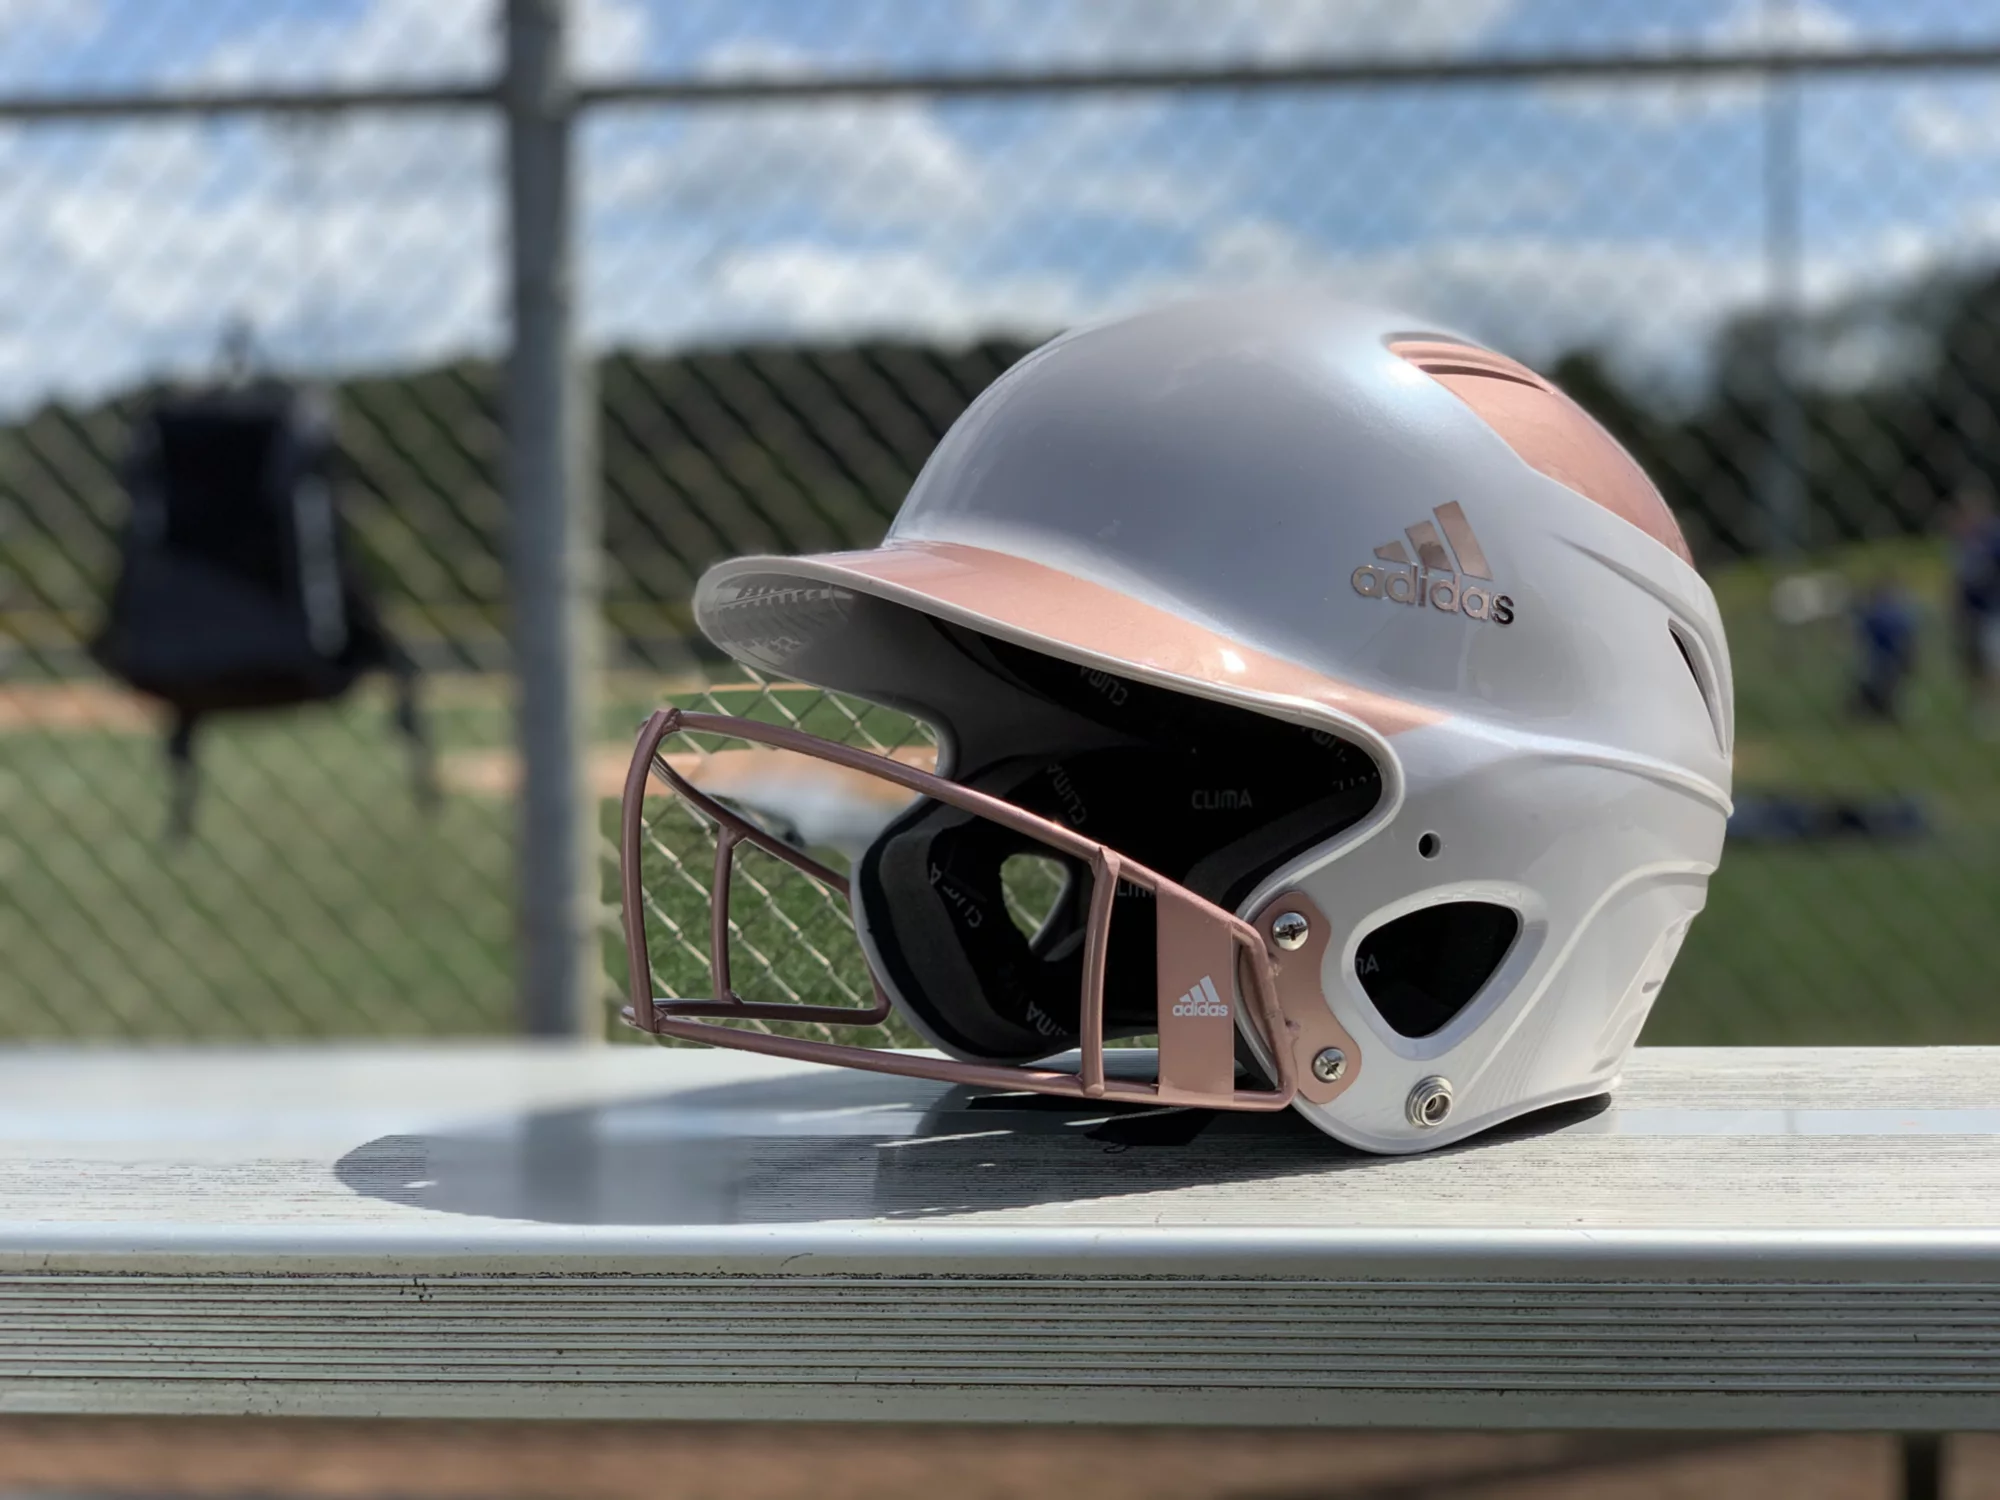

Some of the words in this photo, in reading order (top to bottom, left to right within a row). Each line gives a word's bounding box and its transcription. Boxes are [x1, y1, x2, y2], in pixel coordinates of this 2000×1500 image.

[1351, 561, 1515, 625] adidas
[1046, 764, 1087, 826] CLIMA
[1190, 787, 1253, 810] CLIMA
[1172, 1001, 1228, 1017] adidas
